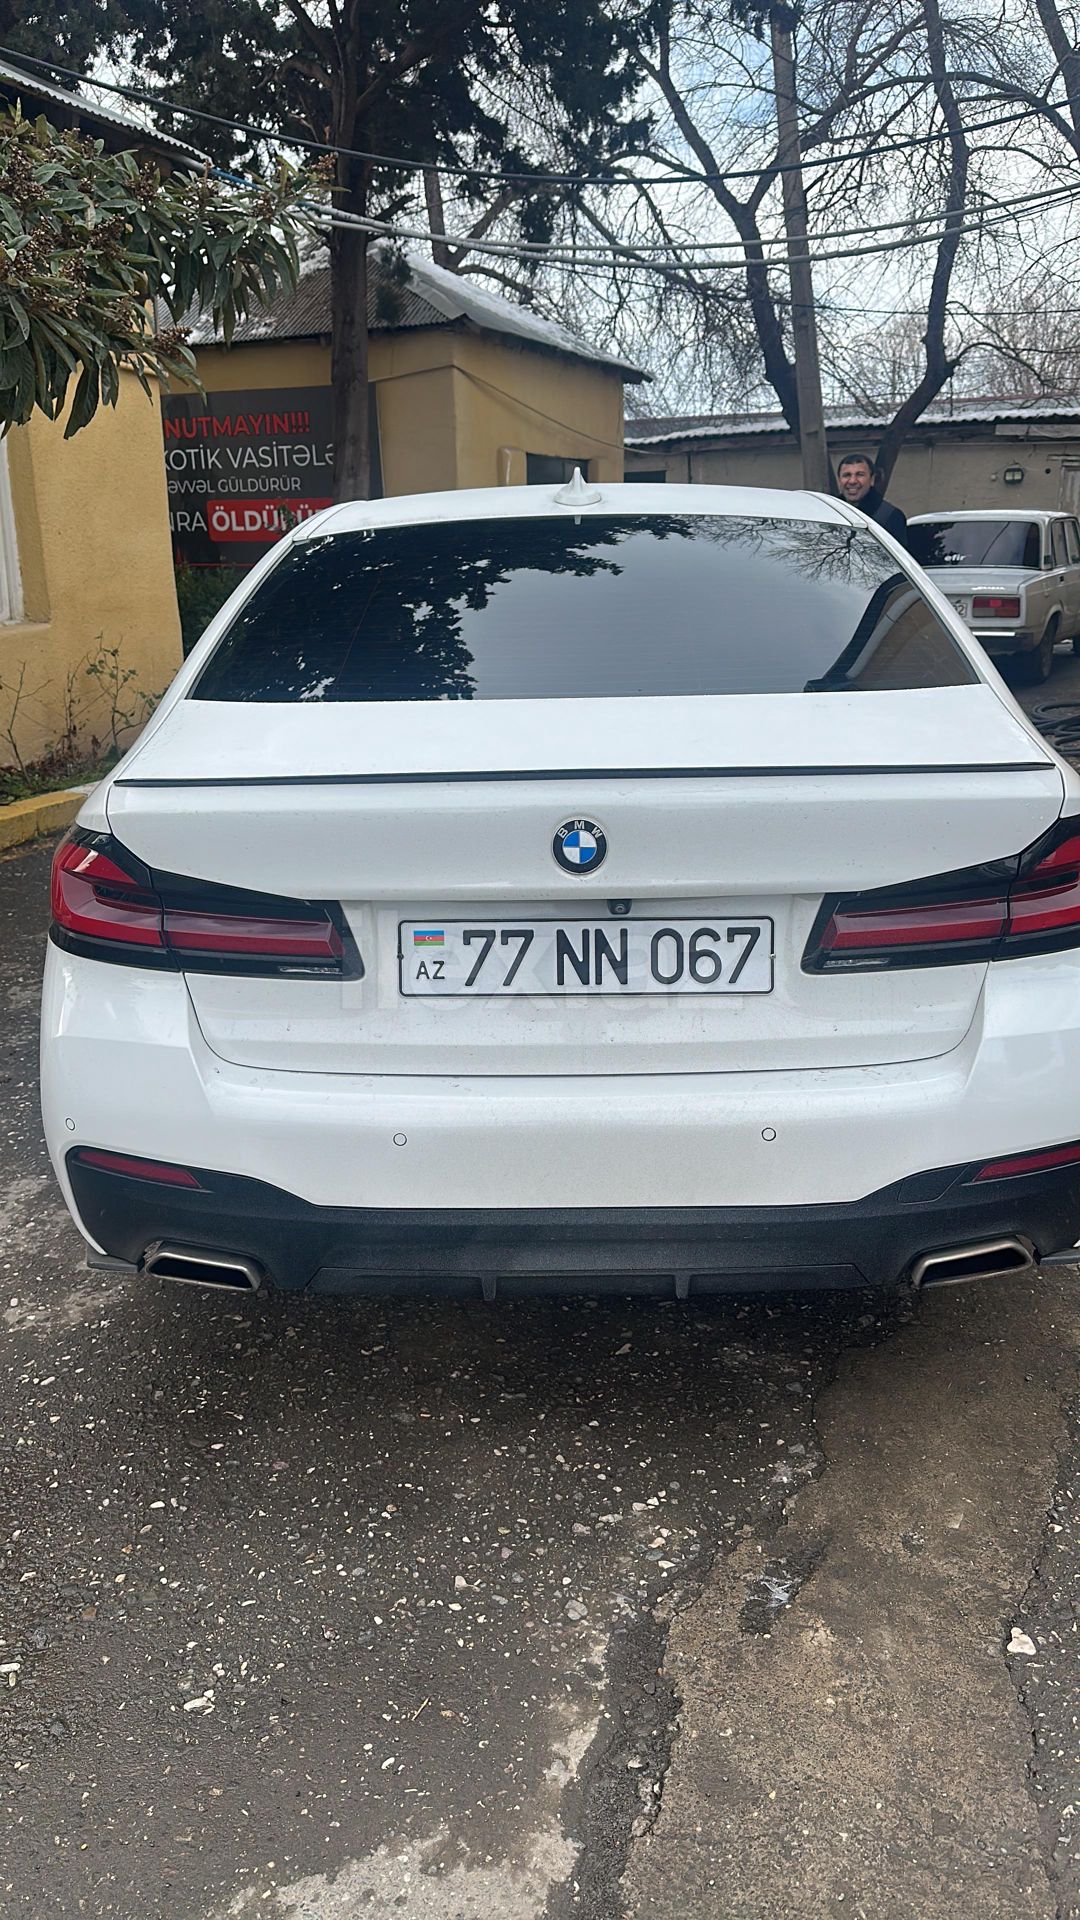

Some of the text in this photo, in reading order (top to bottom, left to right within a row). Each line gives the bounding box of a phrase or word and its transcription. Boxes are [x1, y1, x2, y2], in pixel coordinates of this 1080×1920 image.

[217, 474, 301, 494] GÜLDÜRÜR
[557, 820, 603, 839] BMW
[416, 926, 761, 987] AZ 77 NN 067
